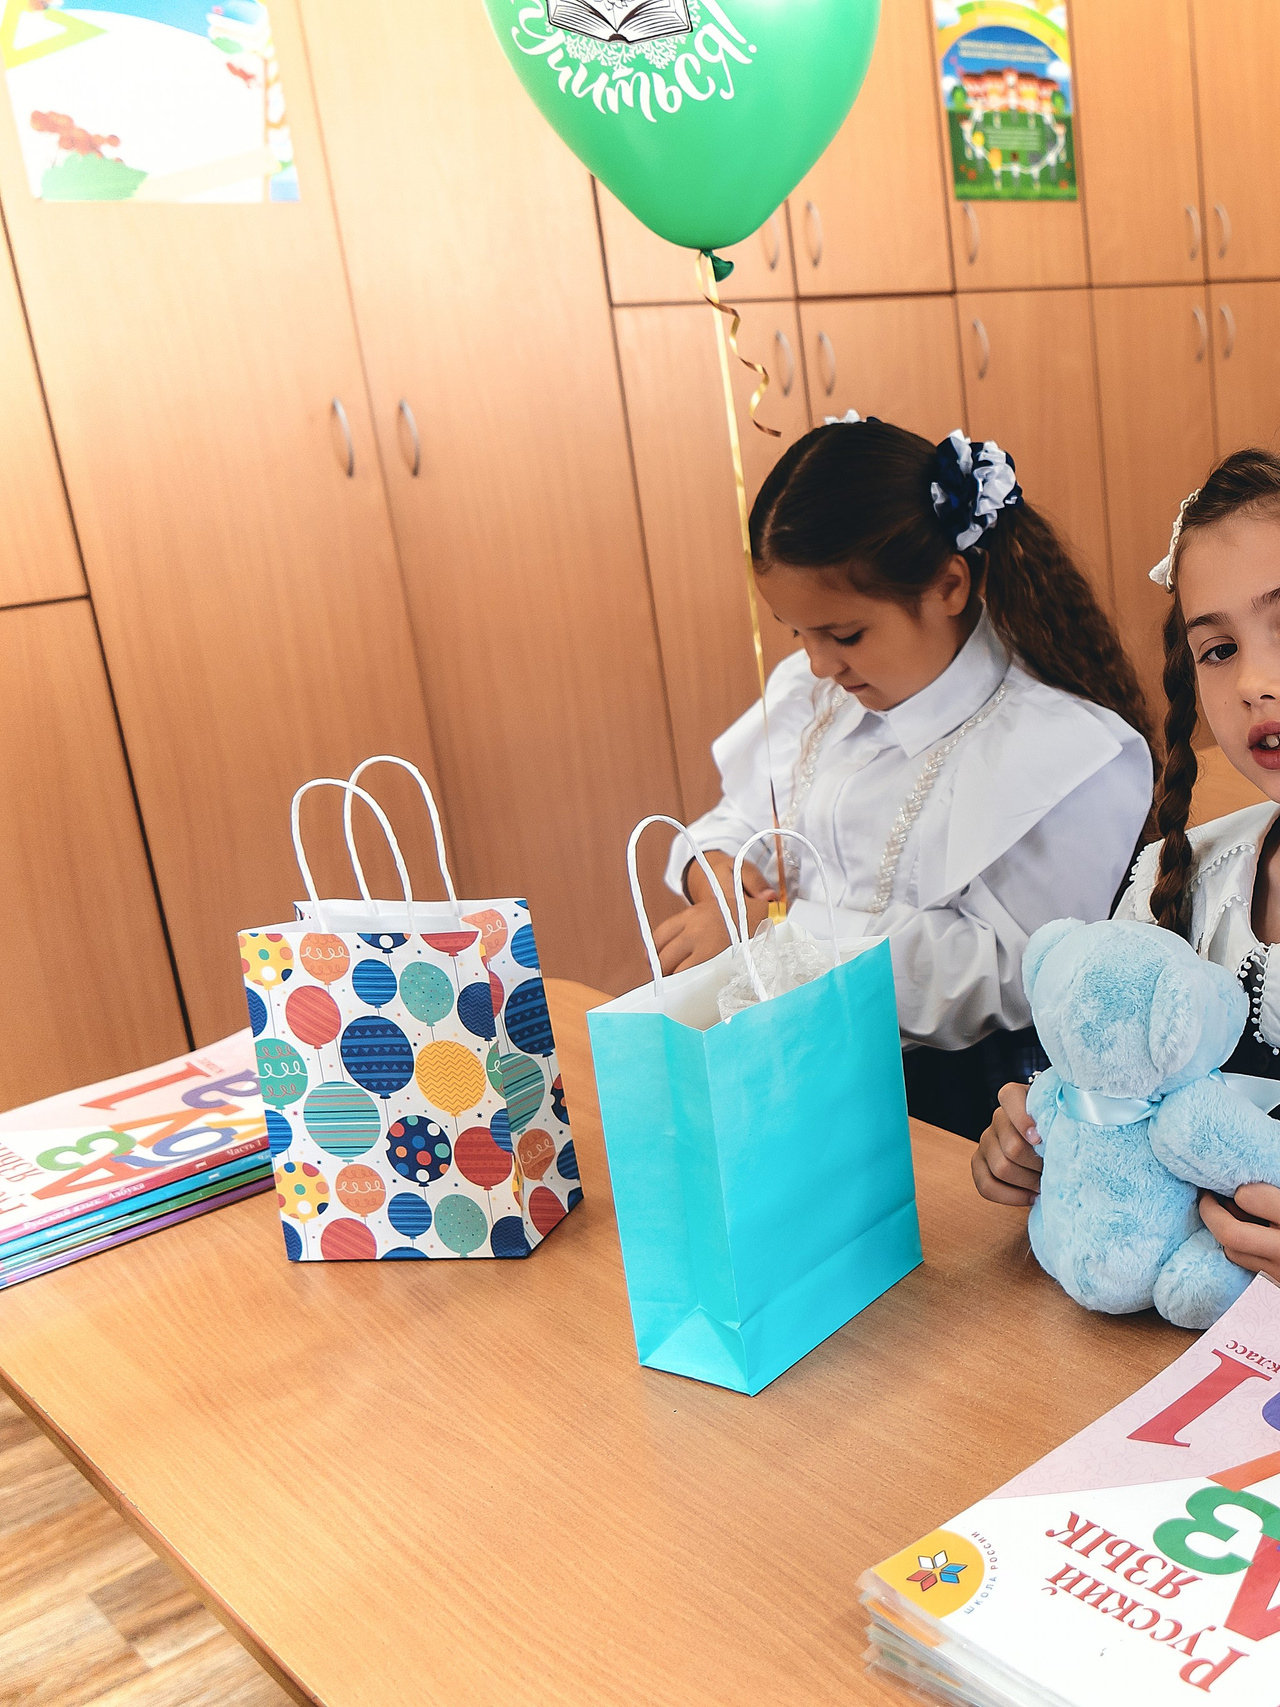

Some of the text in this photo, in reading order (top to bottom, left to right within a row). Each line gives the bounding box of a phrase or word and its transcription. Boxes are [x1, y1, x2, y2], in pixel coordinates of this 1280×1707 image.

[226, 1144, 255, 1156] Часть
[1126, 1348, 1271, 1447] 1
[964, 1531, 998, 1614] ШКОЛА РОССИИ
[1041, 1562, 1250, 1693] Русский
